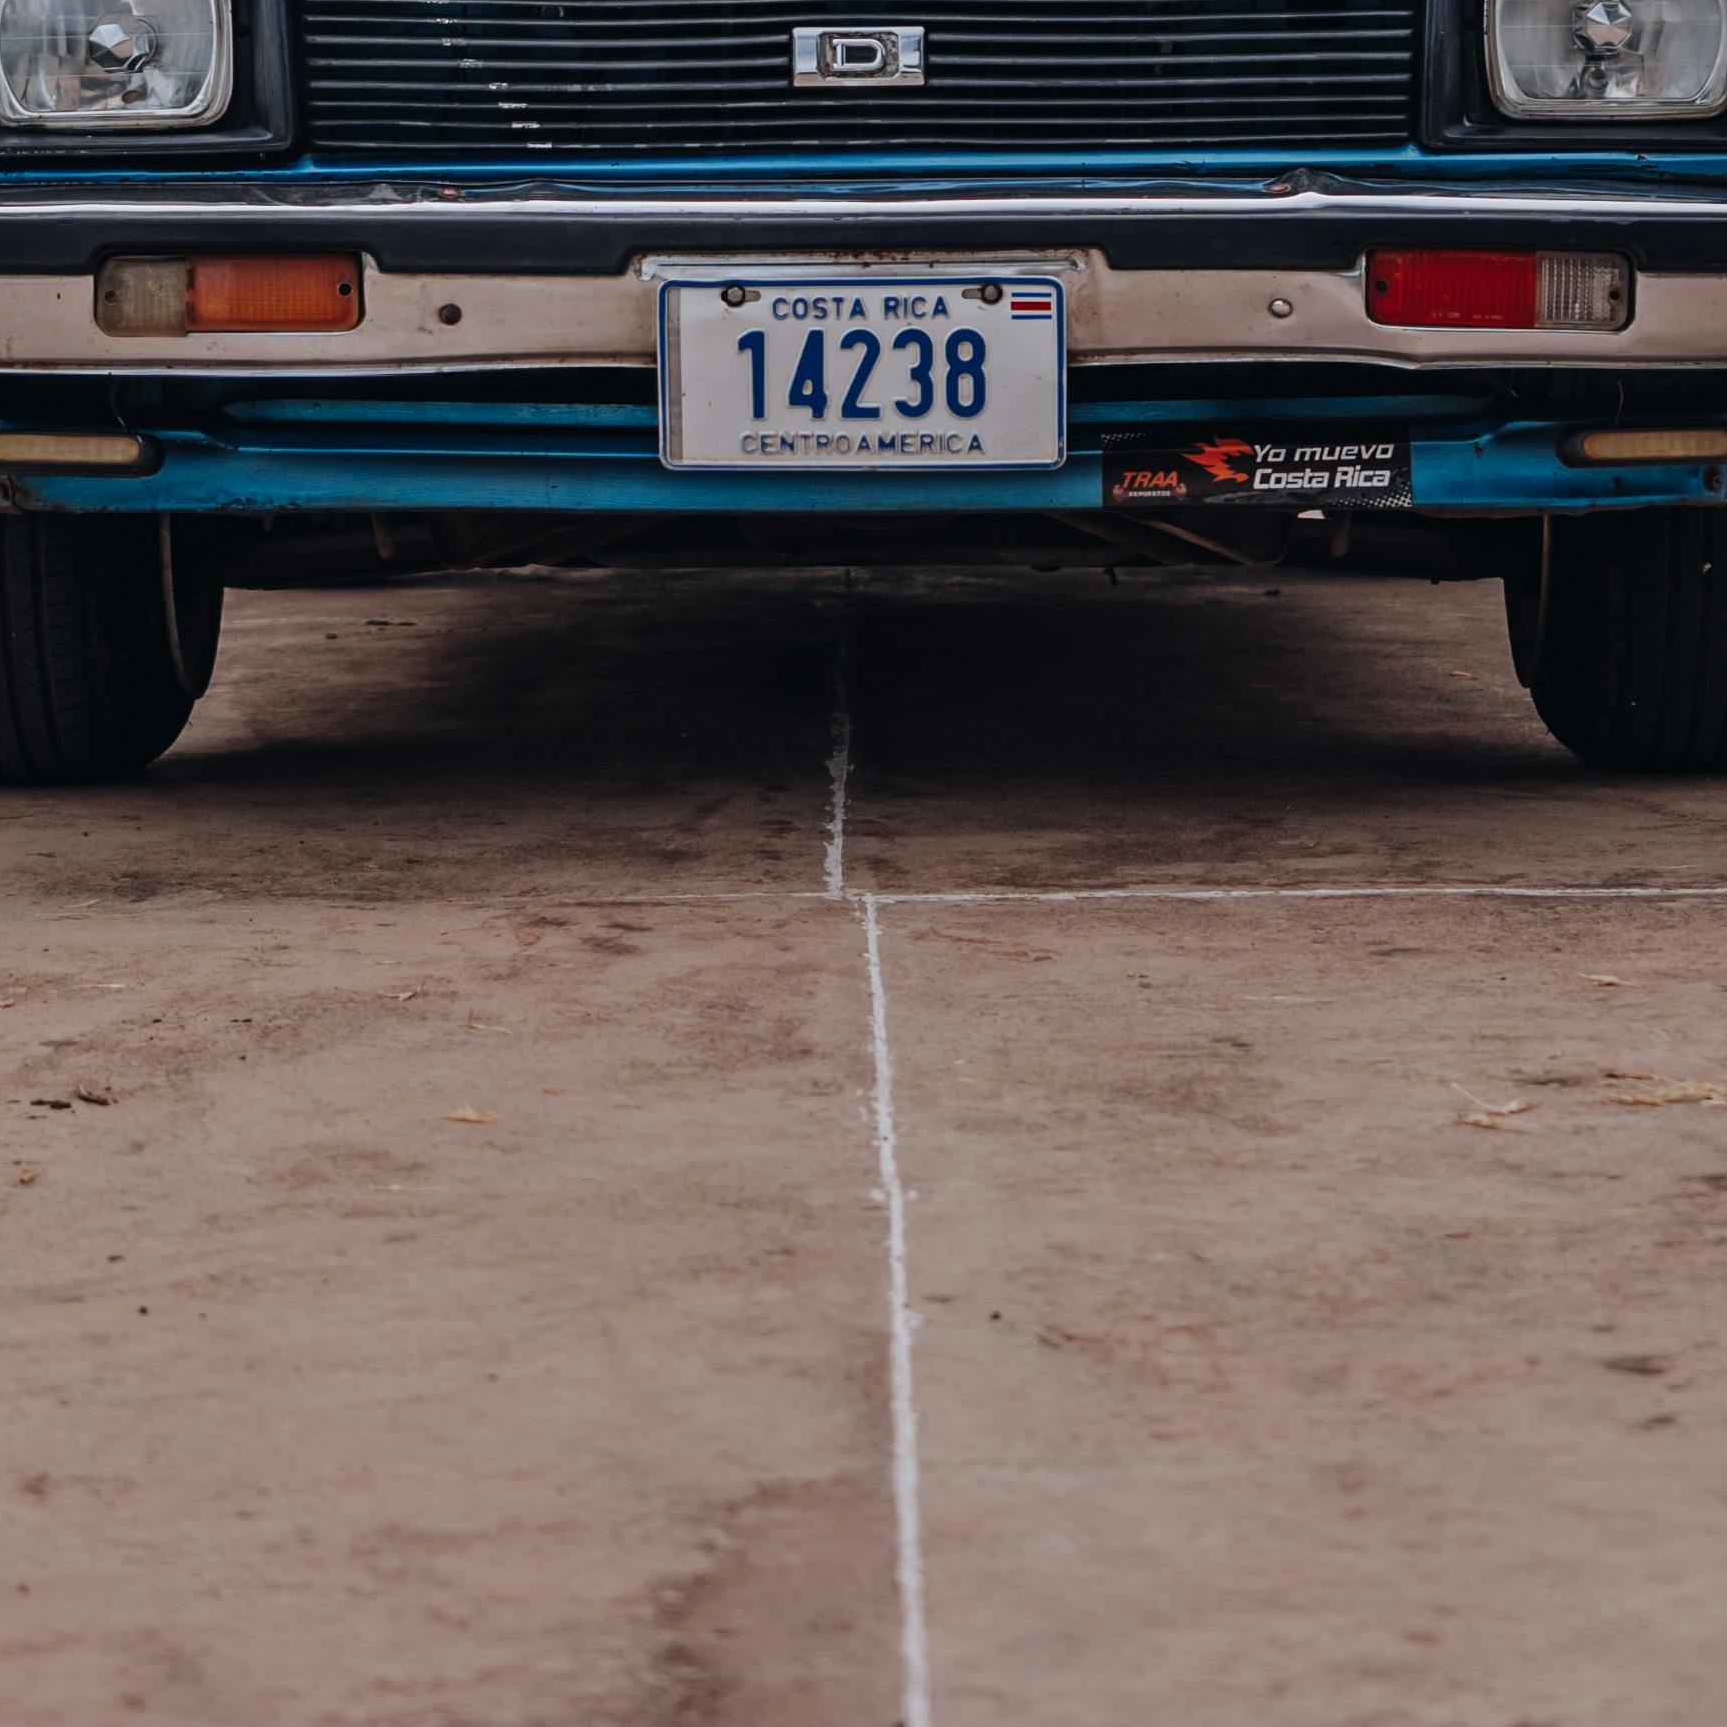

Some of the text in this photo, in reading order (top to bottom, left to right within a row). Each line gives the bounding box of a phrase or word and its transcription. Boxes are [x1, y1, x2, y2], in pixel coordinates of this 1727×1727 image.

[832, 38, 887, 72] D
[772, 295, 950, 321] COSTA RICA
[737, 328, 987, 419] 14238
[741, 433, 984, 455] CENTROAMERICA
[1253, 443, 1395, 463] Yo muevo
[1123, 471, 1178, 488] TRAA
[1253, 465, 1391, 490] Costa Rica
